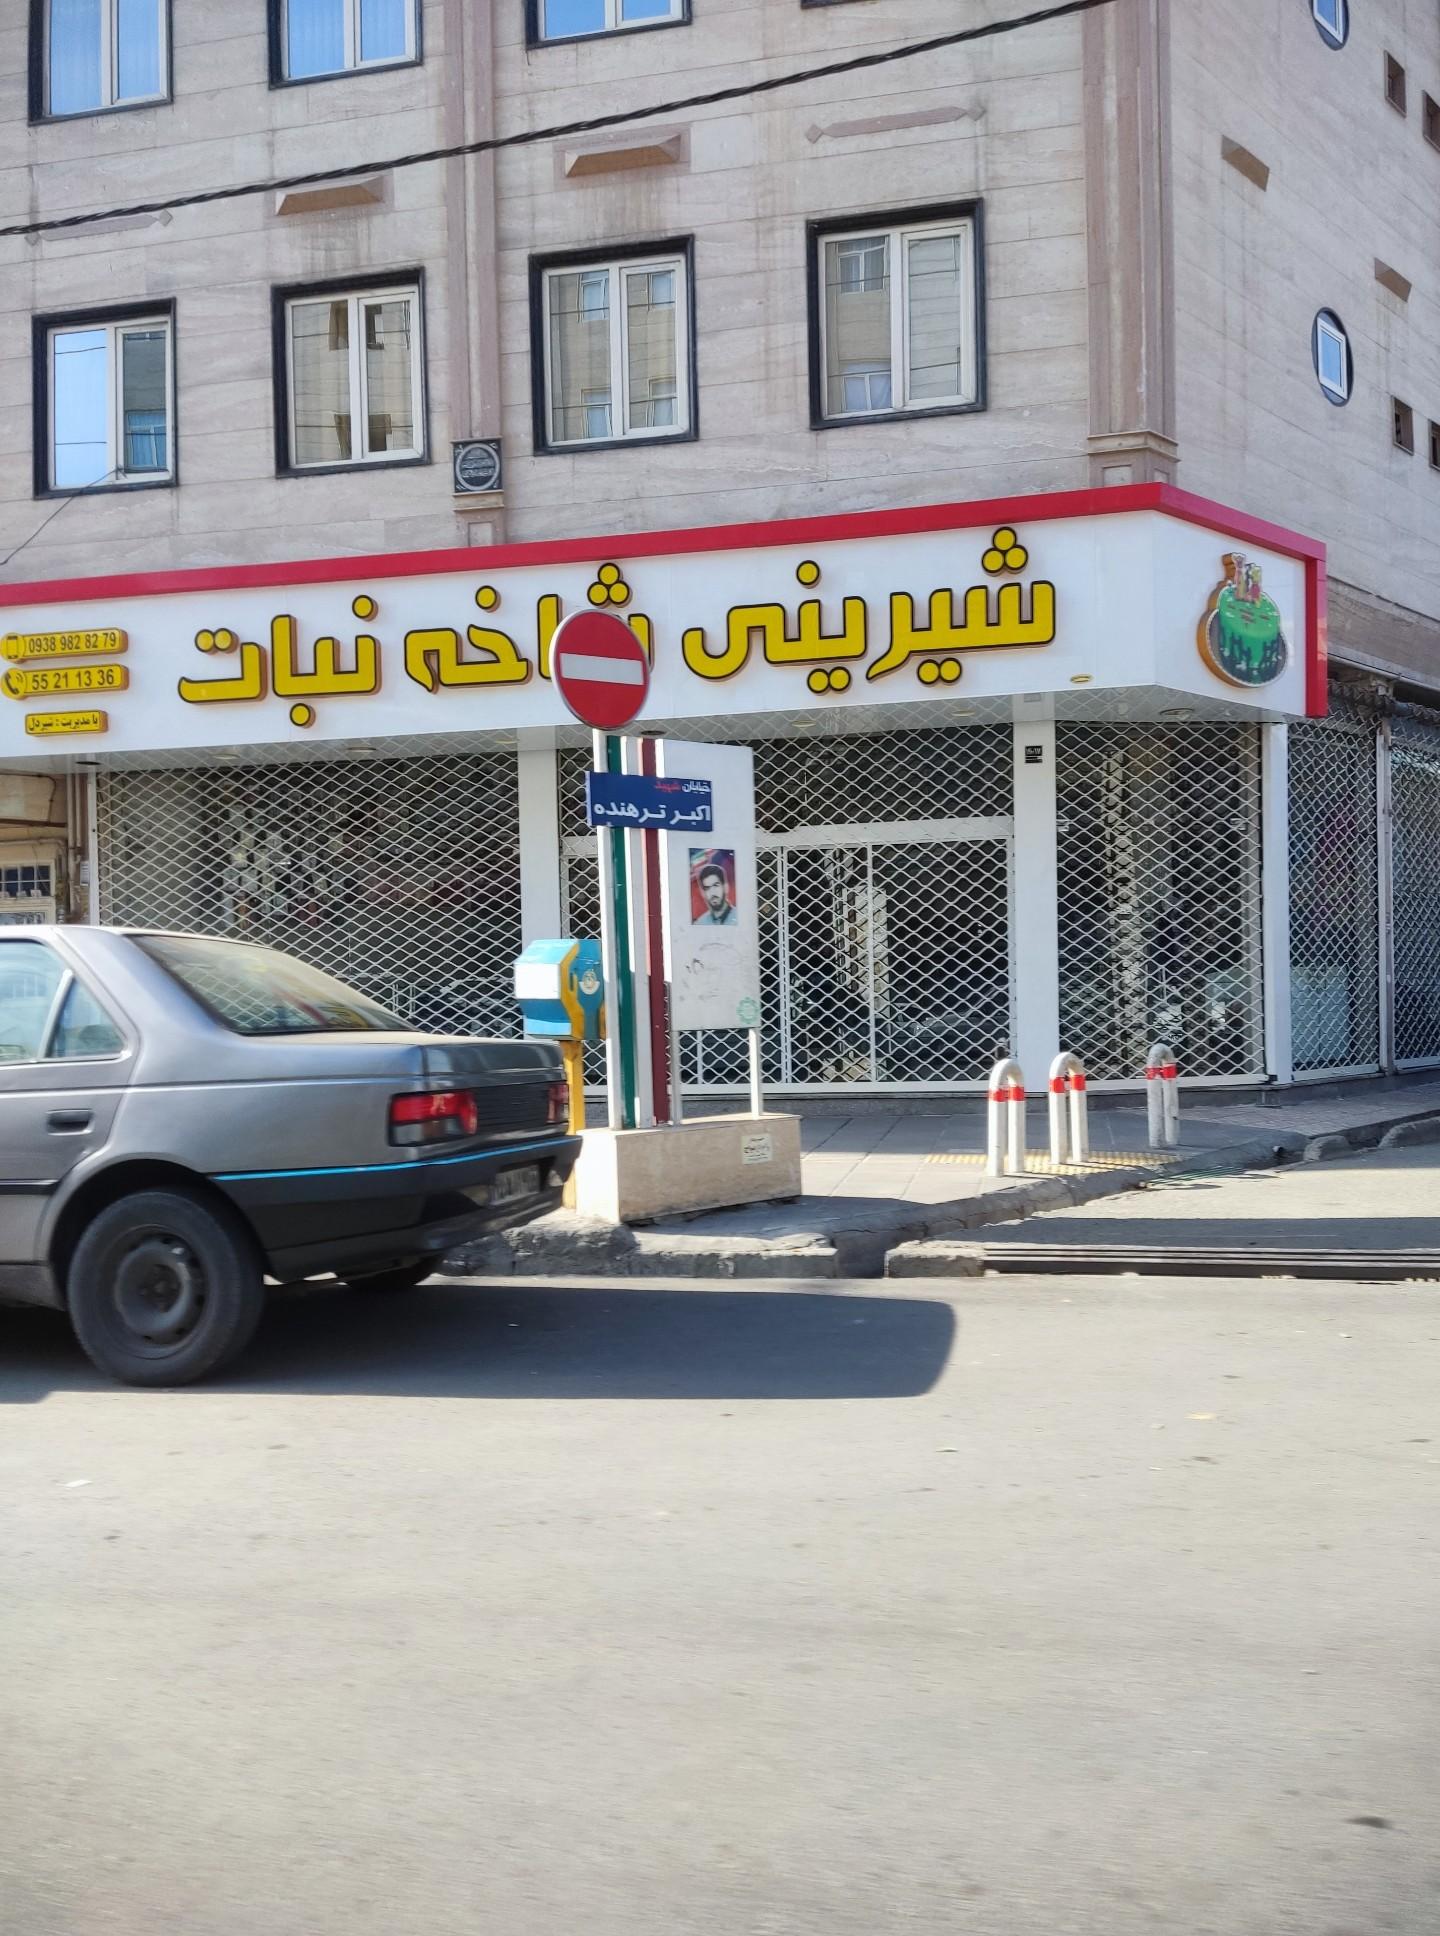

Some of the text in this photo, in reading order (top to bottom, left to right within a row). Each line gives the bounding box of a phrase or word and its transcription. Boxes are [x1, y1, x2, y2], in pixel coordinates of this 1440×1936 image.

[681, 526, 1057, 694] شیرینی
[28, 632, 116, 653] 0938 982 82 79
[177, 593, 379, 728] نبات
[32, 669, 114, 690] 55 21 13 36
[682, 781, 711, 795] خیابان
[669, 804, 711, 826] اکبر
